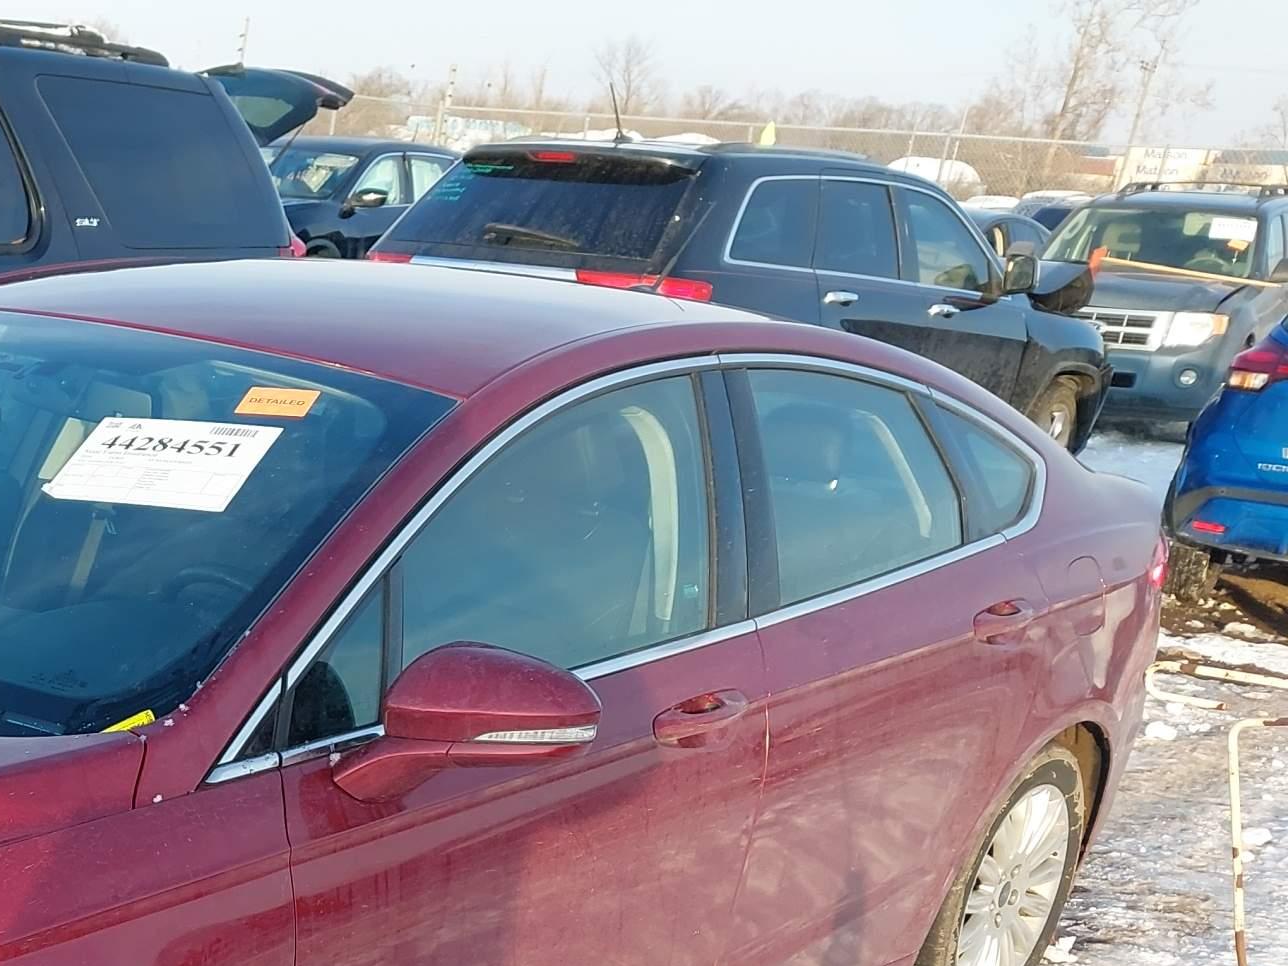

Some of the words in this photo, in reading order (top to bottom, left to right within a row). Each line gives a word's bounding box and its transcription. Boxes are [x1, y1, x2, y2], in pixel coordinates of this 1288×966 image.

[1144, 150, 1188, 160] Mason
[1135, 165, 1179, 176] Maton
[249, 397, 306, 406] DETAILED
[101, 435, 242, 458] 44284551
